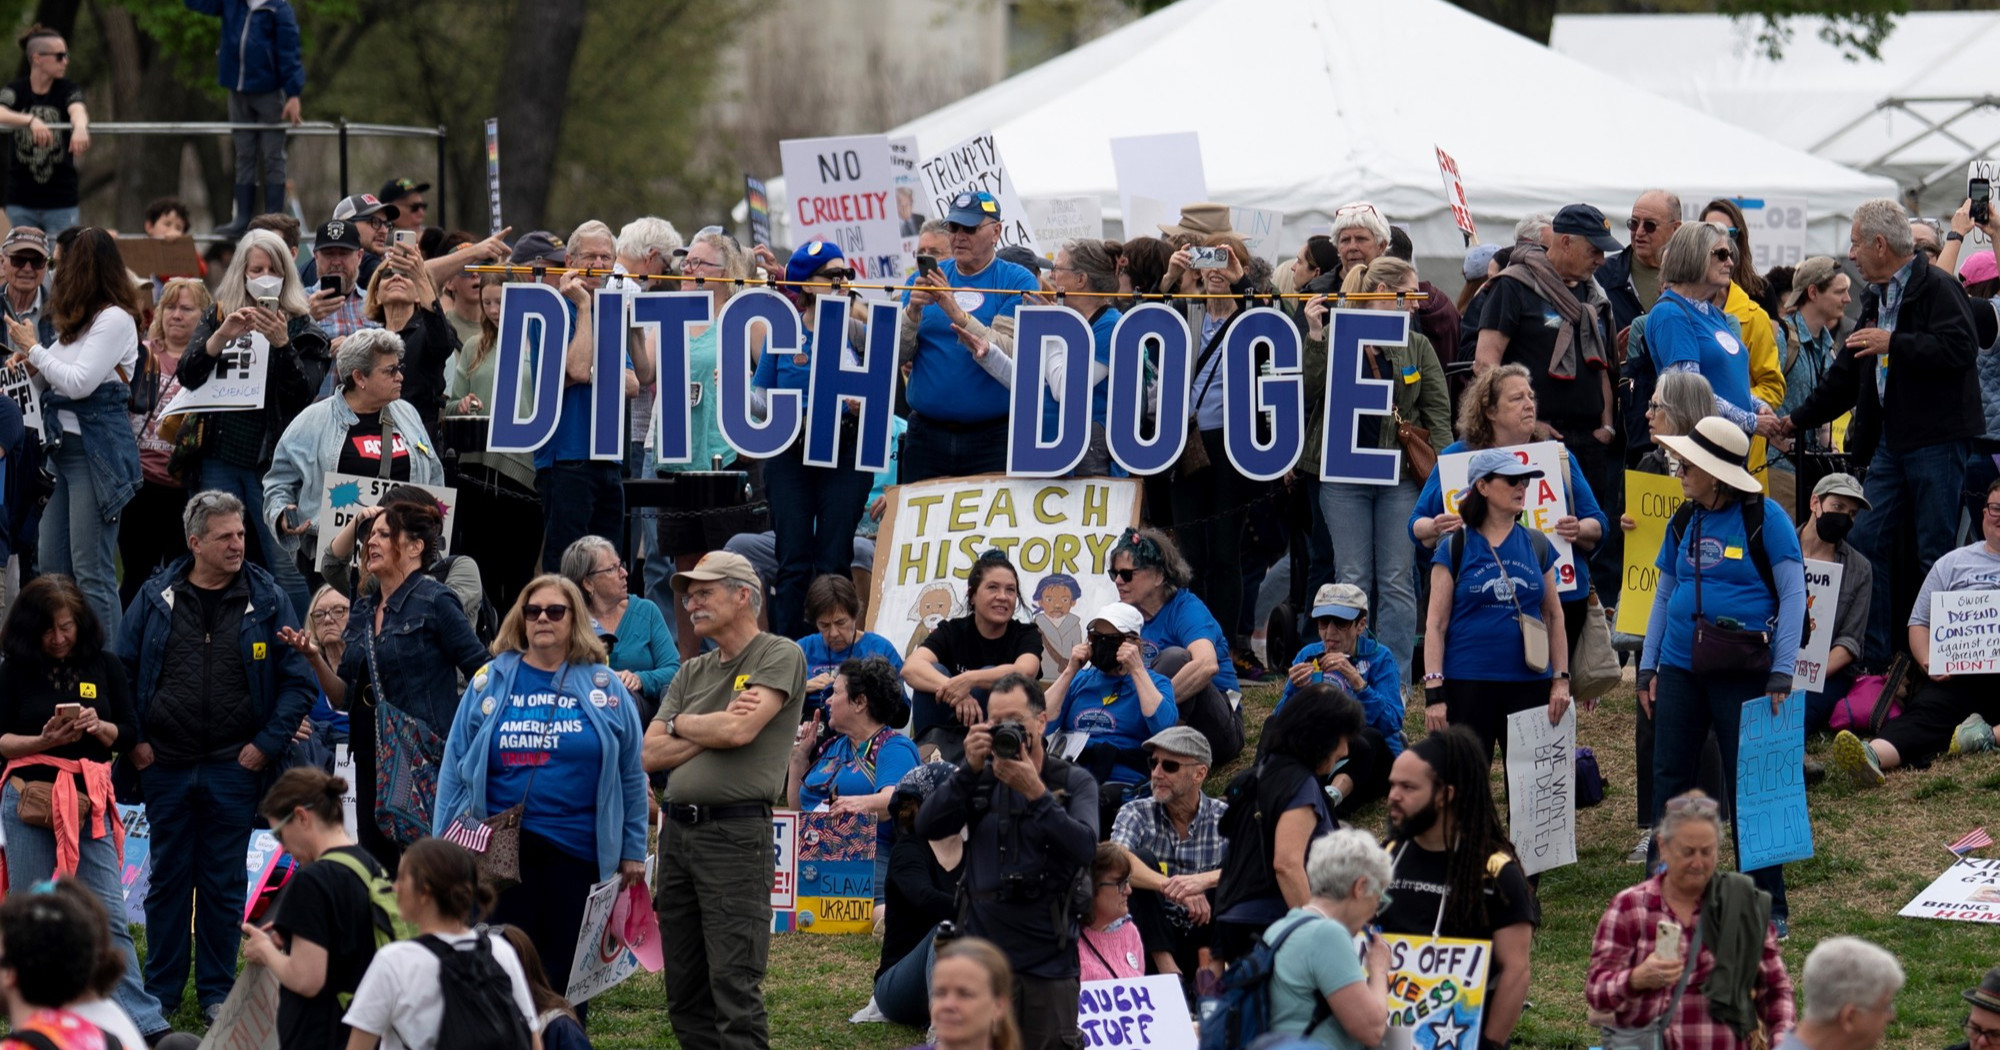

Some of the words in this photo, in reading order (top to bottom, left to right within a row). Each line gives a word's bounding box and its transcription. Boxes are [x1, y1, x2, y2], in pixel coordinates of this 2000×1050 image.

[817, 150, 861, 184] NO
[797, 191, 887, 227] CRUELTY
[836, 226, 864, 253] IN
[849, 255, 902, 280] NAME
[486, 281, 903, 473] DITCH
[1006, 302, 1411, 486] DOGE
[907, 484, 1109, 538] TEACH
[898, 533, 1117, 586] HISTORY
[523, 708, 578, 720] MILLION
[528, 694, 556, 706] ONE
[558, 697, 577, 709] OF
[500, 720, 582, 733] AMERICANS
[500, 735, 560, 749] AGAINST
[1552, 735, 1568, 774] WE
[501, 752, 551, 766] TRUMP
[1534, 743, 1551, 771] BE
[1534, 772, 1552, 858] DELETED
[1552, 775, 1568, 833] WON'T
[821, 875, 872, 896] SLAVA
[820, 899, 872, 921] UKRAINI
[1922, 901, 1990, 911] BRING
